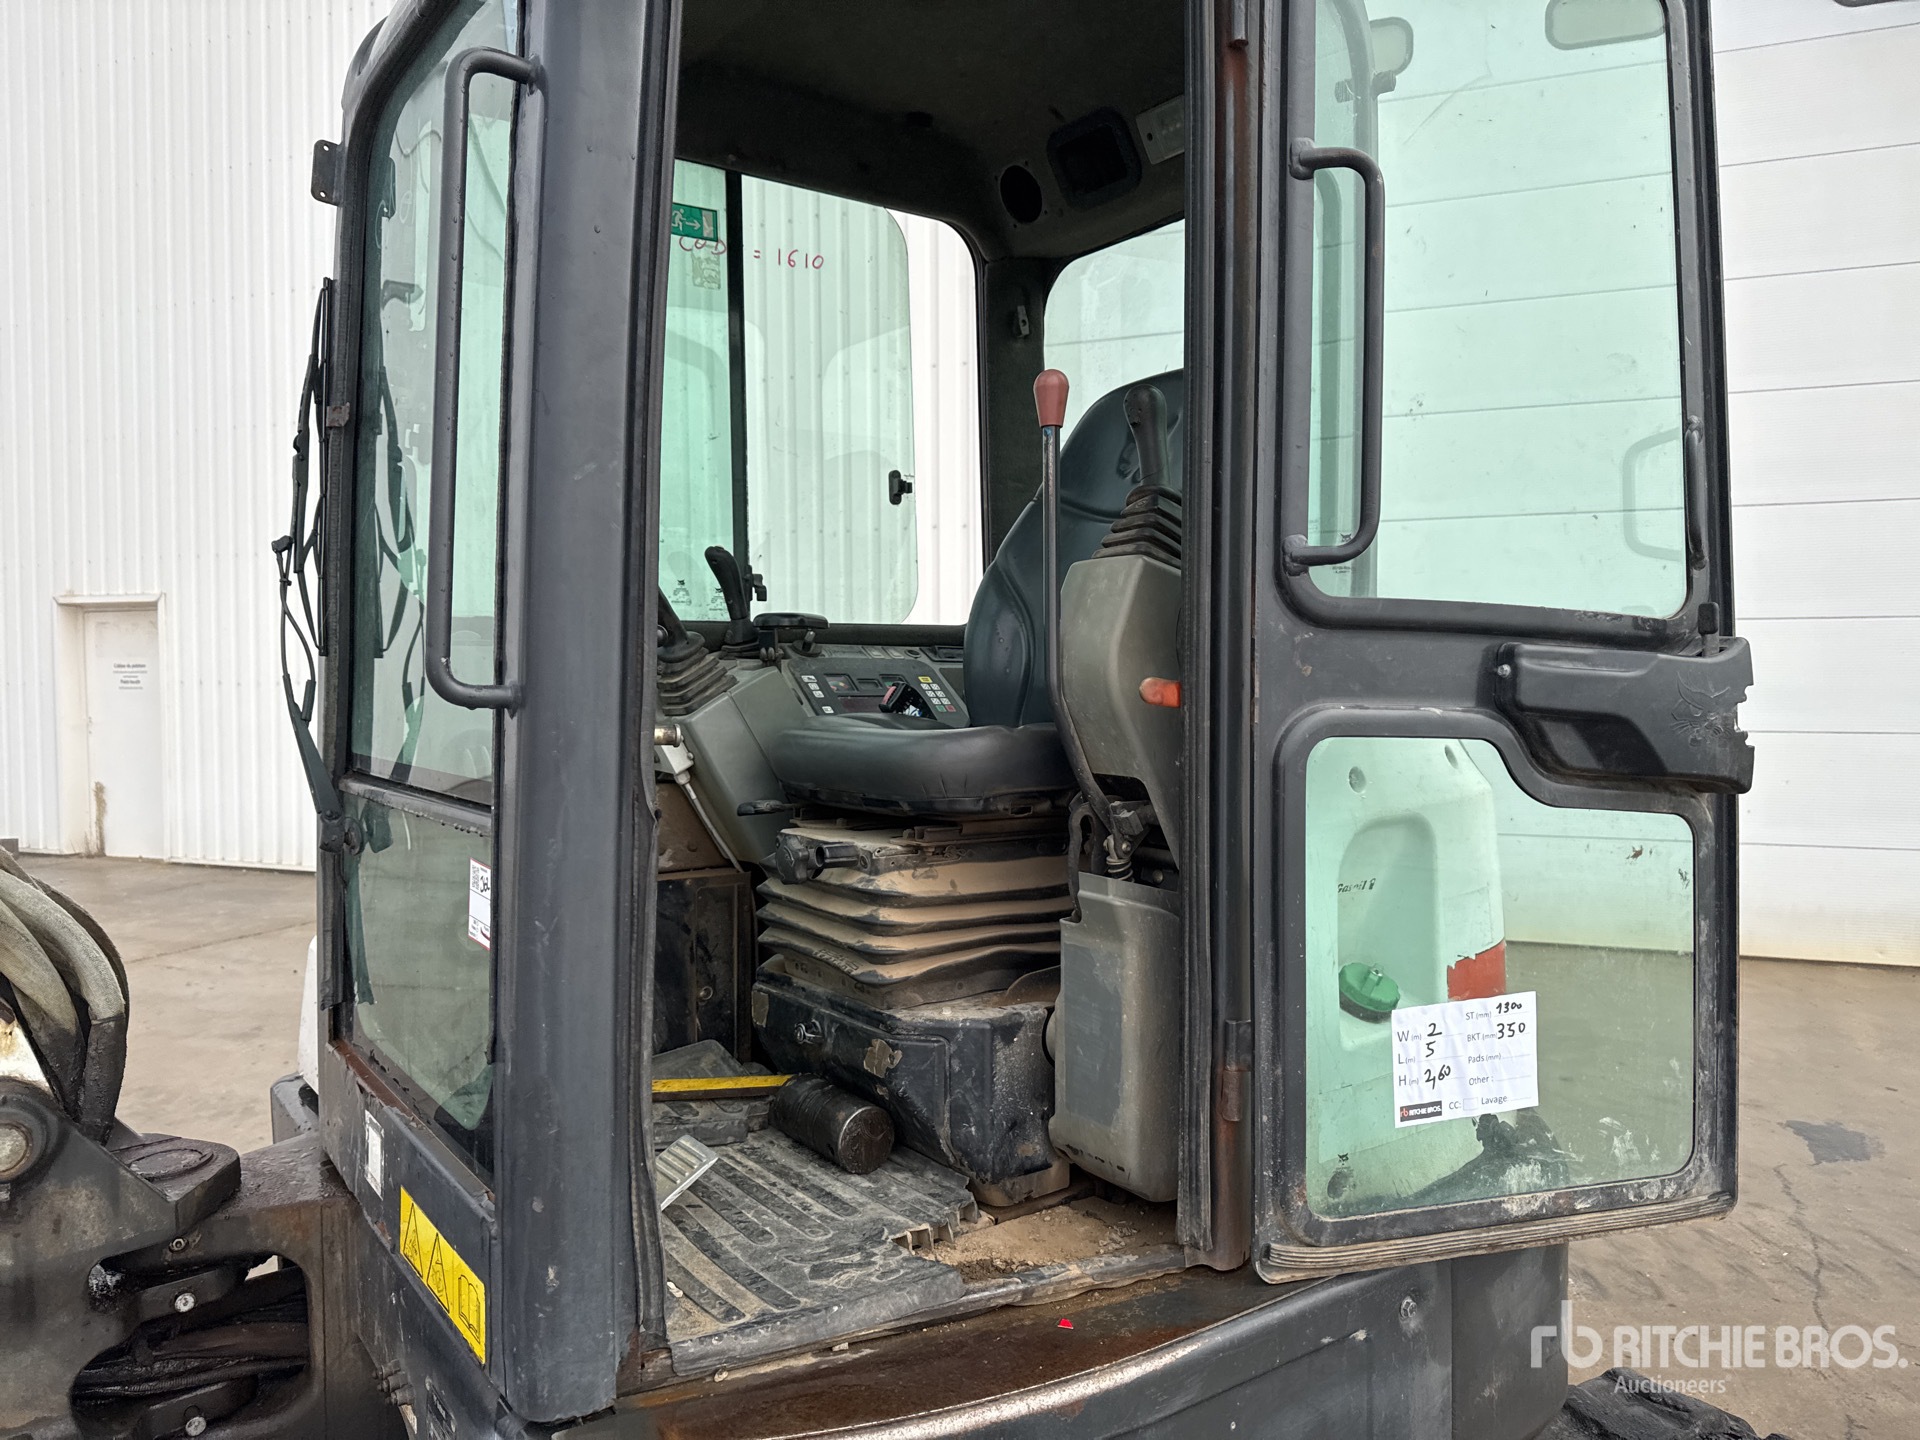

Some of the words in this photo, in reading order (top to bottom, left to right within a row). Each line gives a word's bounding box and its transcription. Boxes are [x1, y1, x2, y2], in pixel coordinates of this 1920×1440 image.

[777, 248, 824, 270] 1610
[1465, 1011, 1475, 1021] ST
[1496, 1001, 1523, 1014] 1300
[1397, 1030, 1410, 1042] W
[1427, 1022, 1443, 1037] 2
[1466, 1032, 1481, 1042] BKT
[1497, 1021, 1526, 1040] 350
[1425, 1040, 1436, 1058] 5
[1467, 1053, 1485, 1064] Pads
[1398, 1074, 1407, 1087] H
[1481, 1095, 1508, 1105] Lavage
